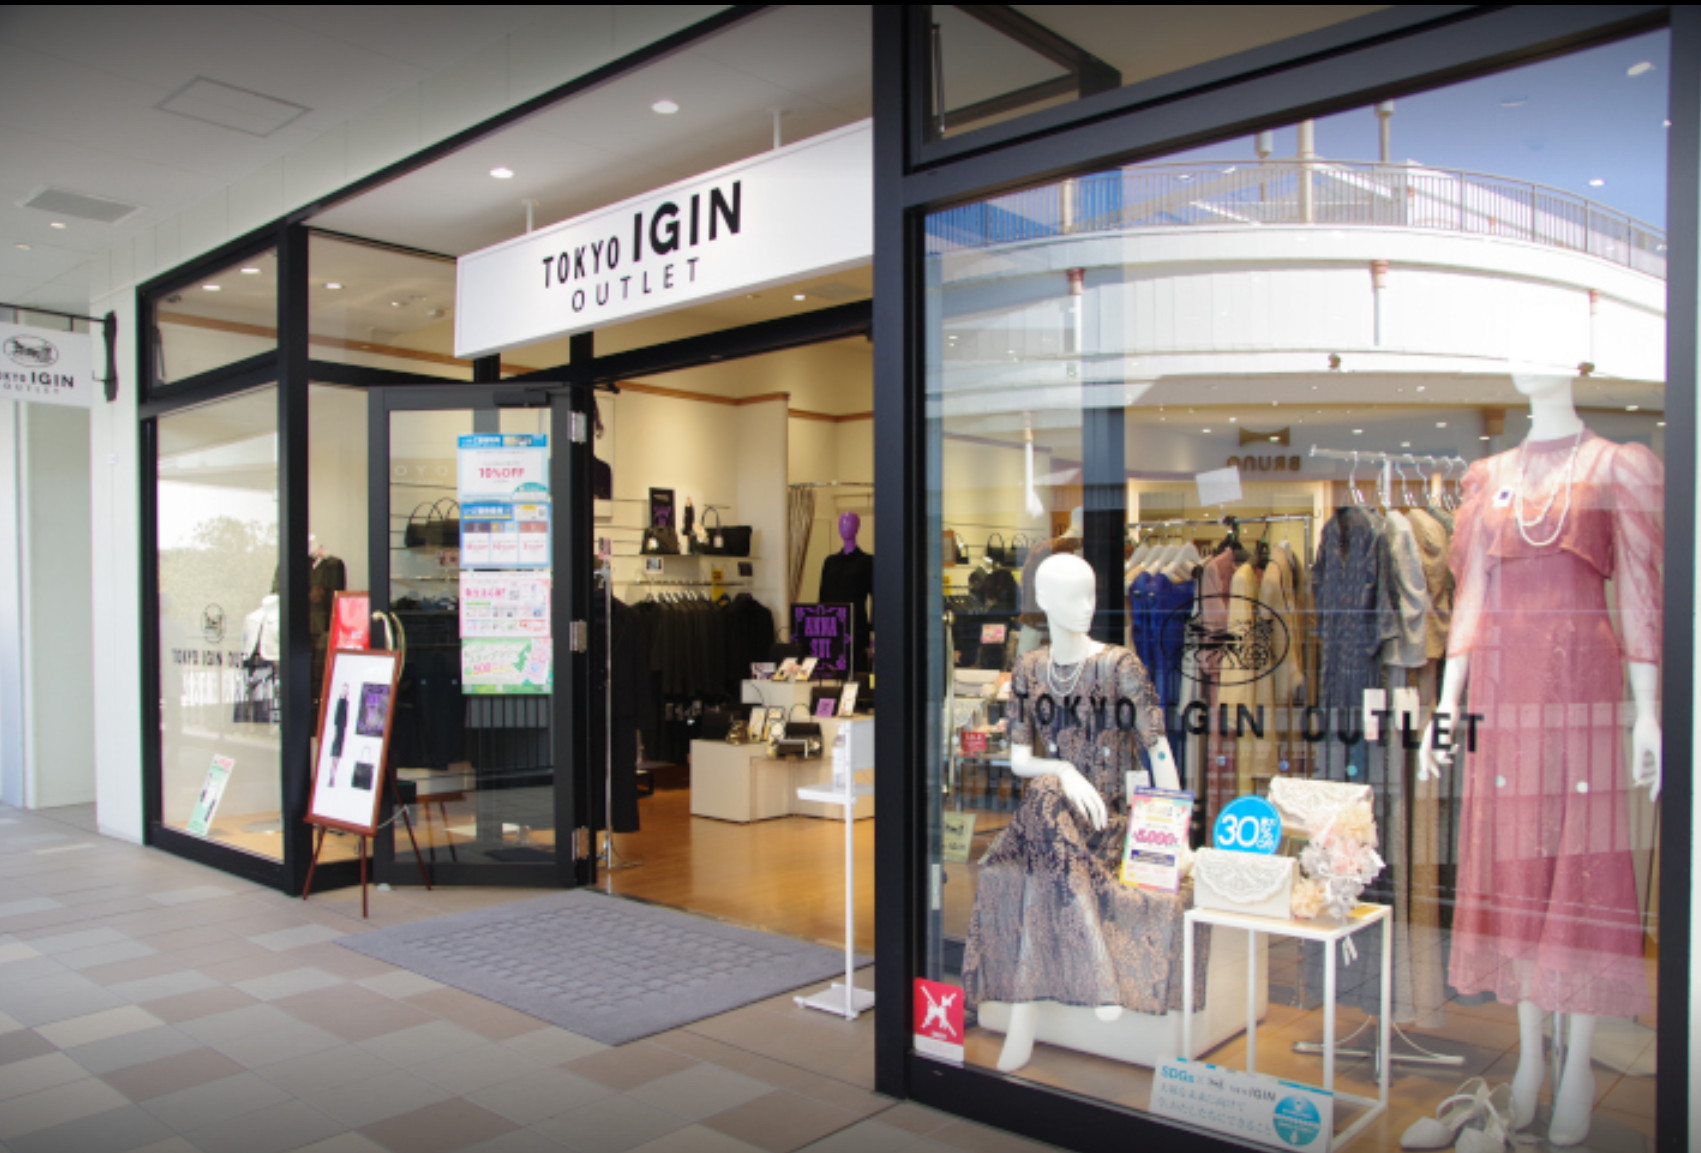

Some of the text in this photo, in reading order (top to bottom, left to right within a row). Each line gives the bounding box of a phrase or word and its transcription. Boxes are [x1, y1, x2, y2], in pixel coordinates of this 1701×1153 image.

[542, 180, 741, 289] TOKYO IGIN
[571, 257, 700, 313] OUTLET
[0, 371, 74, 388] KYO IGIN
[1016, 692, 1137, 731] TOKYO
[1301, 705, 1485, 752] OUTLET
[1218, 814, 1260, 848] 30
[1162, 1065, 1195, 1083] SDGs
